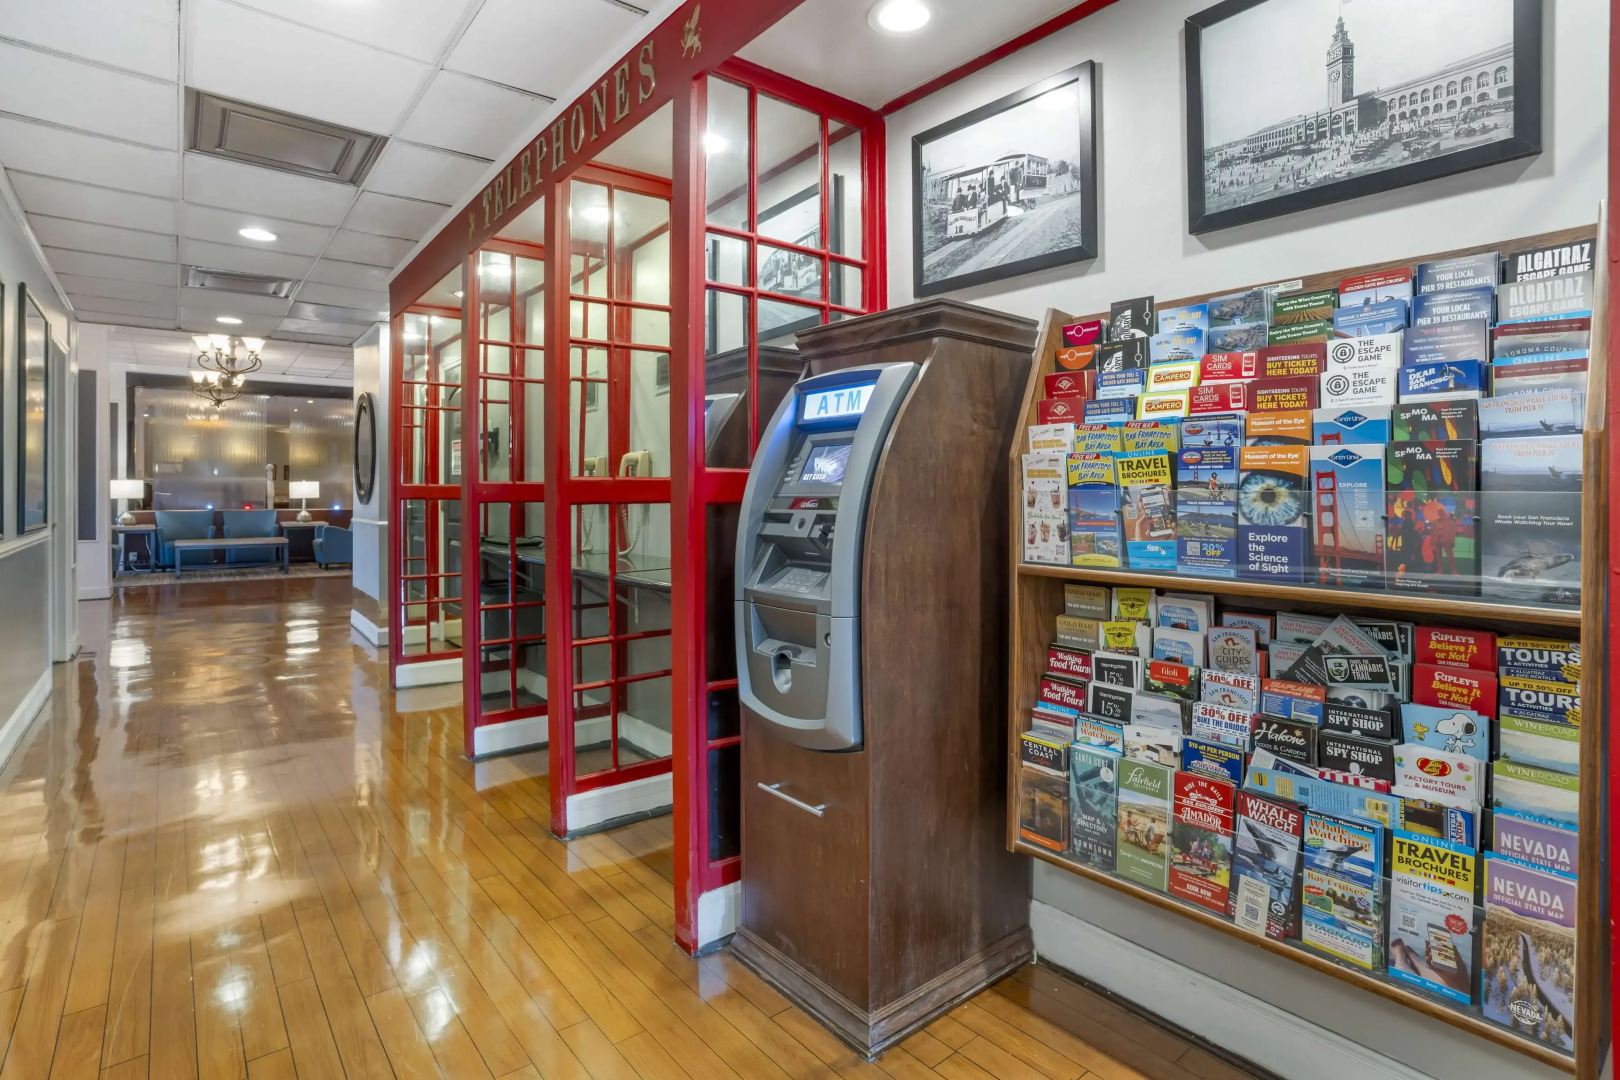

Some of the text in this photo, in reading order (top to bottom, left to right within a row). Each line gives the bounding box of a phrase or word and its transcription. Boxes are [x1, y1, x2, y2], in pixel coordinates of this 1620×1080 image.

[482, 40, 656, 228] TELEPHONES
[1517, 243, 1591, 274] ALCATRAZ
[1436, 269, 1475, 280] YOUR LOCAL
[1421, 276, 1491, 292] PIER 39 RESTAURANTS
[1509, 276, 1584, 307] ALCATRAZ
[1432, 302, 1471, 314] YOUR LOCAL
[1509, 297, 1585, 318] ESCAPE GAME
[1417, 310, 1488, 325] PIER 39 RESTAURANTS
[1358, 339, 1375, 347] THE
[1358, 344, 1392, 354] ESCAPE
[1212, 354, 1228, 362] SIM
[1284, 359, 1317, 368] TICKETS
[1358, 354, 1382, 362] GAME
[1512, 353, 1562, 364] ONLINE
[1206, 362, 1232, 370] CARDS
[1289, 367, 1318, 375] TODAY!
[1154, 373, 1190, 382] CAMPERO
[1352, 371, 1370, 379] THE
[1408, 368, 1436, 381] DEAR
[1352, 378, 1387, 387] ESCAPE
[1197, 387, 1214, 395] SIM
[1352, 386, 1378, 394] GAME
[817, 390, 861, 415] ATM
[1193, 394, 1220, 402] CARDS
[1257, 393, 1307, 403] BUY TICKETS
[1279, 400, 1308, 408] TODAY!
[1146, 401, 1182, 412] CAMPERO
[1411, 408, 1427, 416] MO
[1076, 433, 1118, 443] SAN FRANCISCO
[1125, 430, 1172, 440] SAN FRANCISCO
[1097, 441, 1111, 450] AREA
[1135, 440, 1164, 449] BAY AREA
[1394, 450, 1406, 458] SF
[1416, 452, 1432, 460] MA
[1069, 463, 1081, 472] SAN
[1081, 462, 1112, 471] FRANCISCO
[1119, 458, 1167, 472] TRAVEL
[1121, 470, 1167, 479] BROCHURES
[1248, 532, 1289, 543] Explore
[1201, 543, 1225, 552] 20%
[1248, 543, 1265, 552] the
[1248, 553, 1289, 563] Science
[1248, 563, 1289, 574] of Sight
[1160, 611, 1198, 620] TRAMPOLINE
[1212, 631, 1251, 645] SAN FRANCISCO
[1430, 631, 1475, 644] RIPLEY'S
[1155, 645, 1193, 655] TRAMPOLINE
[1222, 647, 1241, 656] CITY
[1429, 640, 1478, 653] Believe It
[1056, 651, 1083, 665] Walking
[1216, 655, 1250, 664] GUIDES
[1448, 651, 1471, 661] Not!
[1501, 647, 1581, 666] TOURS
[1161, 666, 1178, 677] filoli
[1350, 662, 1384, 673] CANNABIS
[1351, 671, 1372, 681] TRAIL
[1434, 672, 1479, 688] RIPLEY'S
[1431, 680, 1482, 698] Believe It
[1536, 684, 1553, 692] 50%
[1555, 686, 1574, 694] OFF
[1450, 692, 1474, 704] Not!
[1047, 703, 1070, 714] ONLINE
[1101, 700, 1121, 716] 15%
[1200, 706, 1248, 724] 30% OFF
[1328, 709, 1382, 721] INTERNATIONAL
[1196, 715, 1248, 733] BIKE THE BRIDGE
[1328, 714, 1384, 731] SPY SHOP
[1255, 722, 1306, 746] Hakone
[1023, 741, 1058, 756] CENTRAL
[1028, 748, 1054, 760] COAST
[1188, 741, 1198, 749] $10
[1206, 746, 1218, 754] PER
[1218, 749, 1240, 760] PERSON
[1326, 741, 1382, 756] INTERNATIONAL
[1326, 745, 1383, 765] SPY SHOP
[1124, 767, 1162, 790] fairfield
[1404, 774, 1466, 791] FACTORY TOURS
[1421, 784, 1456, 796] MUSEUM
[1246, 797, 1298, 827] WHALE
[1076, 817, 1108, 834] DIRECTORY
[1248, 807, 1294, 834] WATCH
[1309, 817, 1348, 835] Whale
[1308, 826, 1371, 853] Watching!
[1411, 834, 1456, 851] ONLINE
[1500, 831, 1571, 866] NEVADA
[1396, 839, 1473, 873] TRAVEL
[1500, 849, 1571, 873] OFFICIAL STATE MAP
[1397, 855, 1469, 882] BROCHURES
[1307, 871, 1369, 898] Bay Cruises!
[1493, 876, 1565, 912] NEVADA
[1493, 892, 1564, 921] OFFICIAL STATE MAP
[1304, 919, 1370, 948] STAGNARO
[1511, 1002, 1542, 1020] NEVADA
